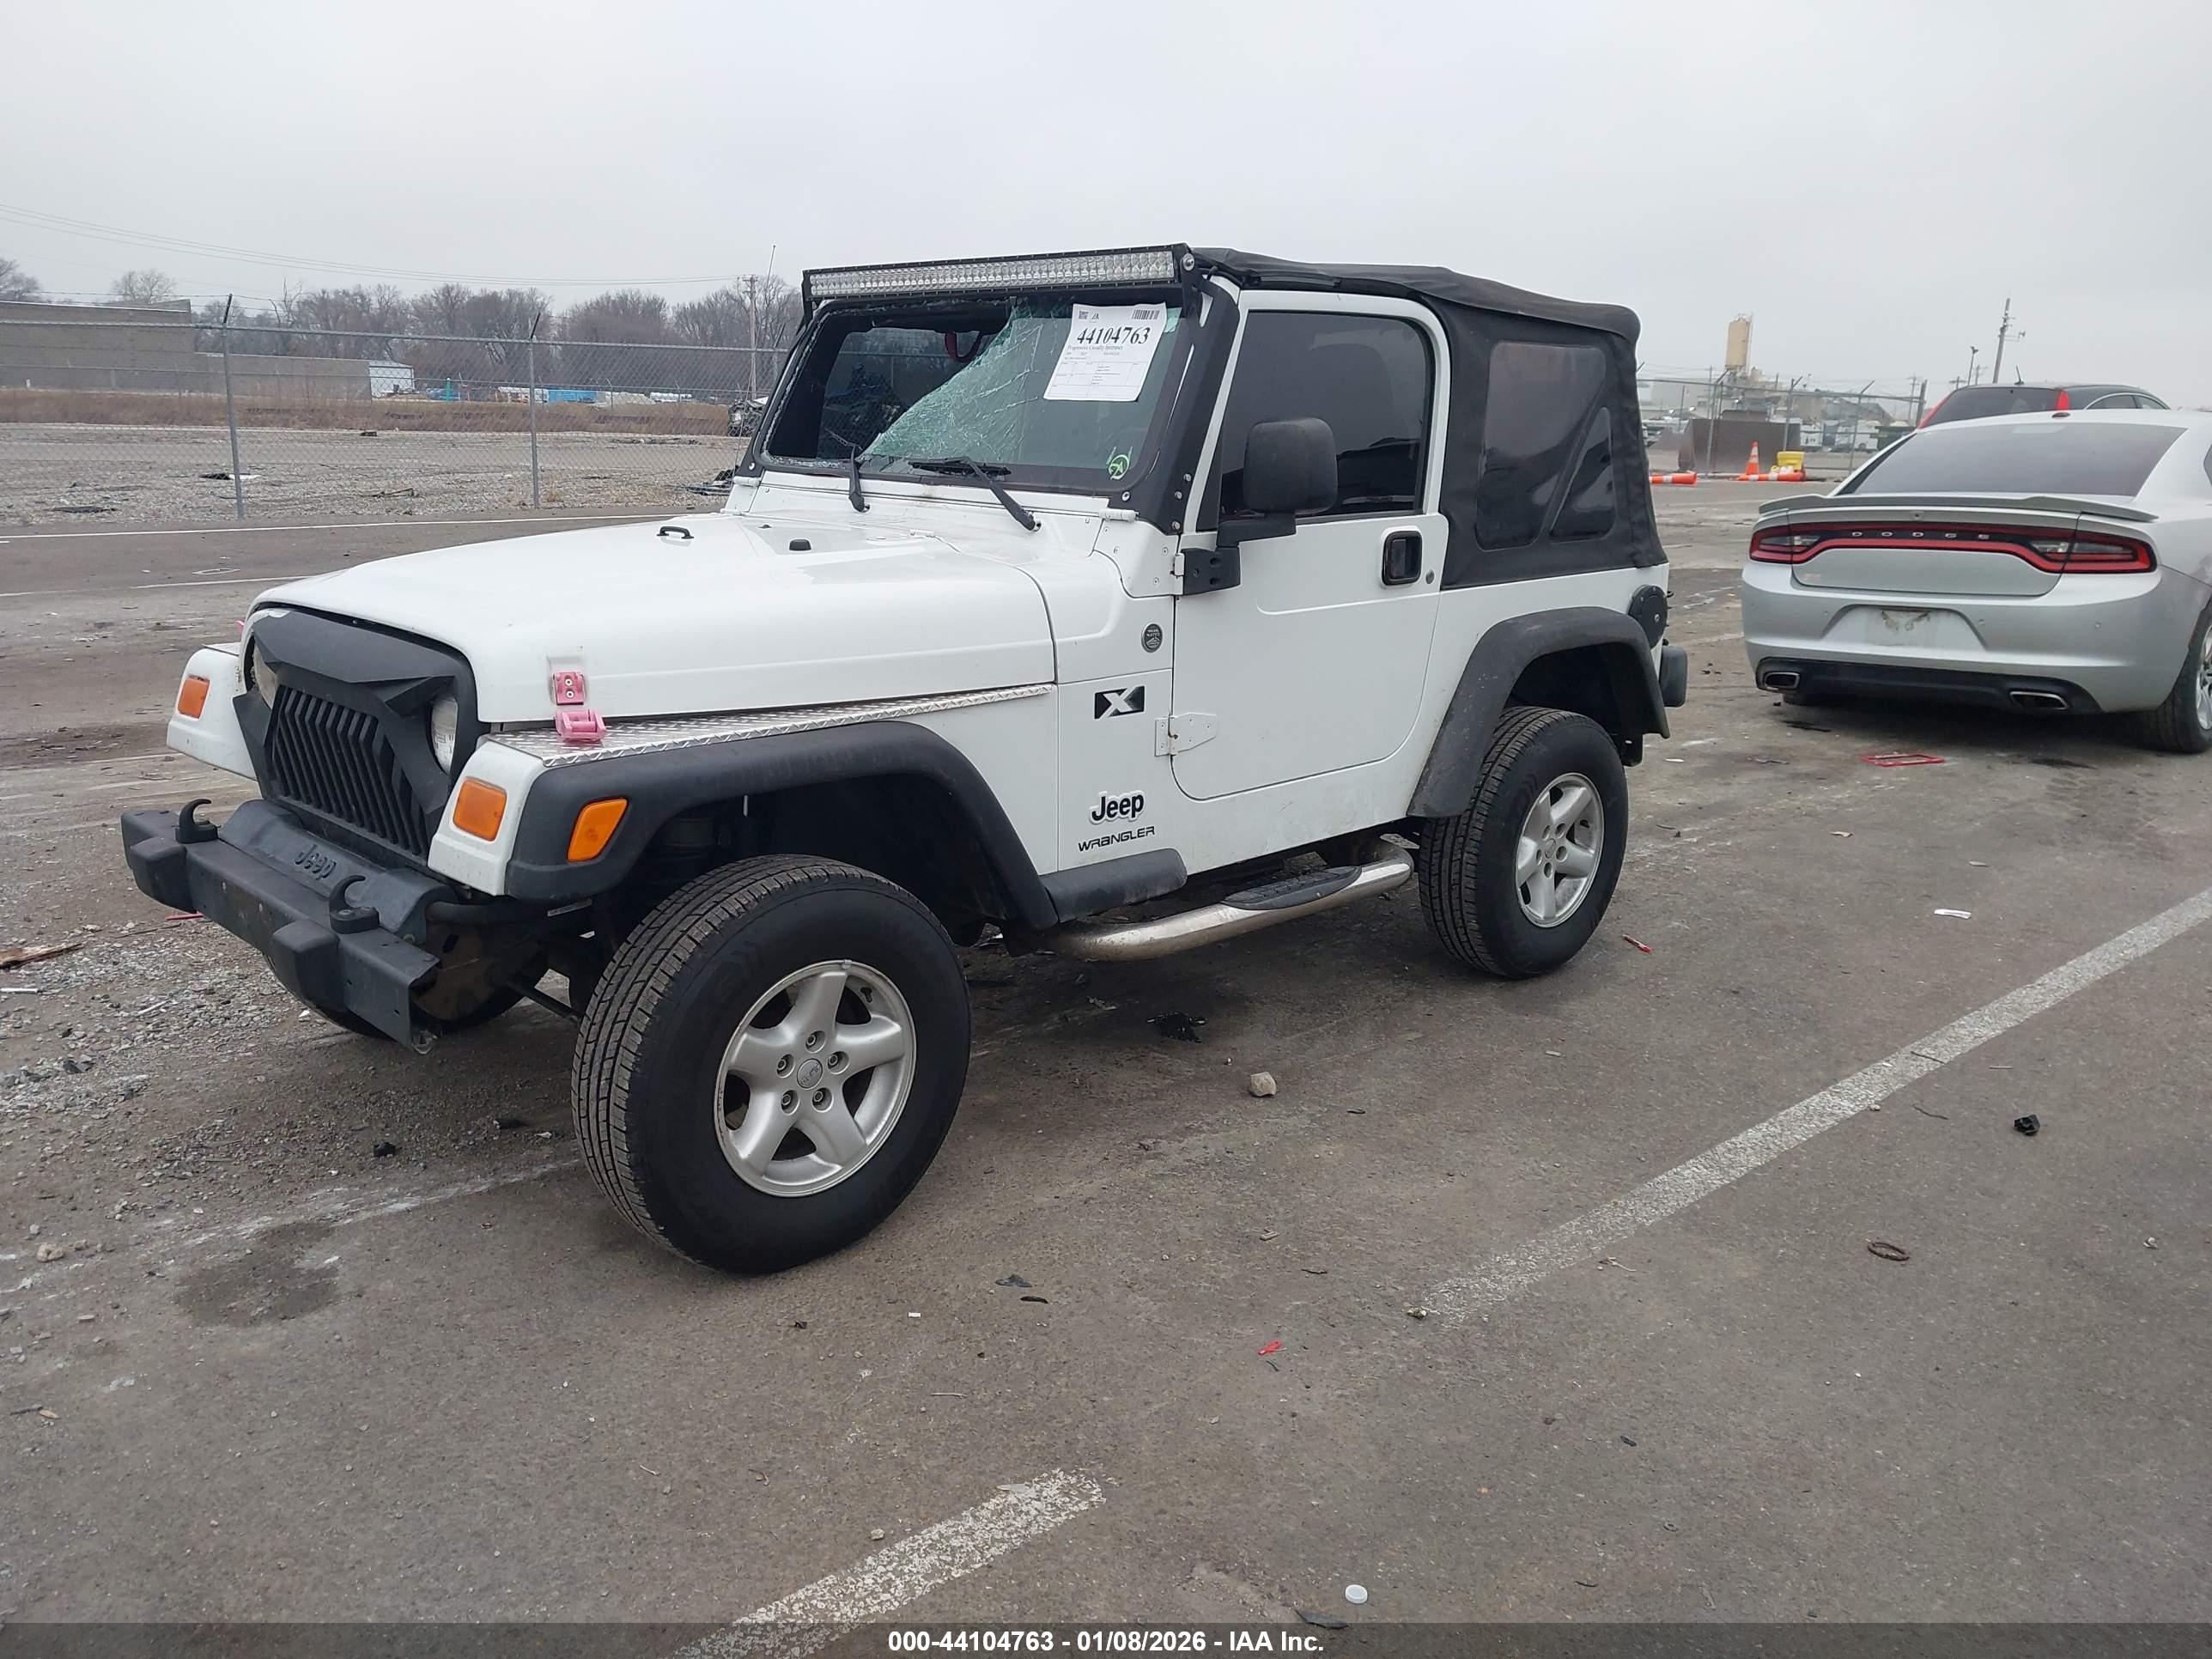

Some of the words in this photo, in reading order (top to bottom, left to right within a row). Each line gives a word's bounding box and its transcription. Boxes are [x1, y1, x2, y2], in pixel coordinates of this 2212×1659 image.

[1076, 325, 1152, 344] 44104763
[1091, 793, 1145, 821] Jeep
[1078, 826, 1155, 852] WRANGLER
